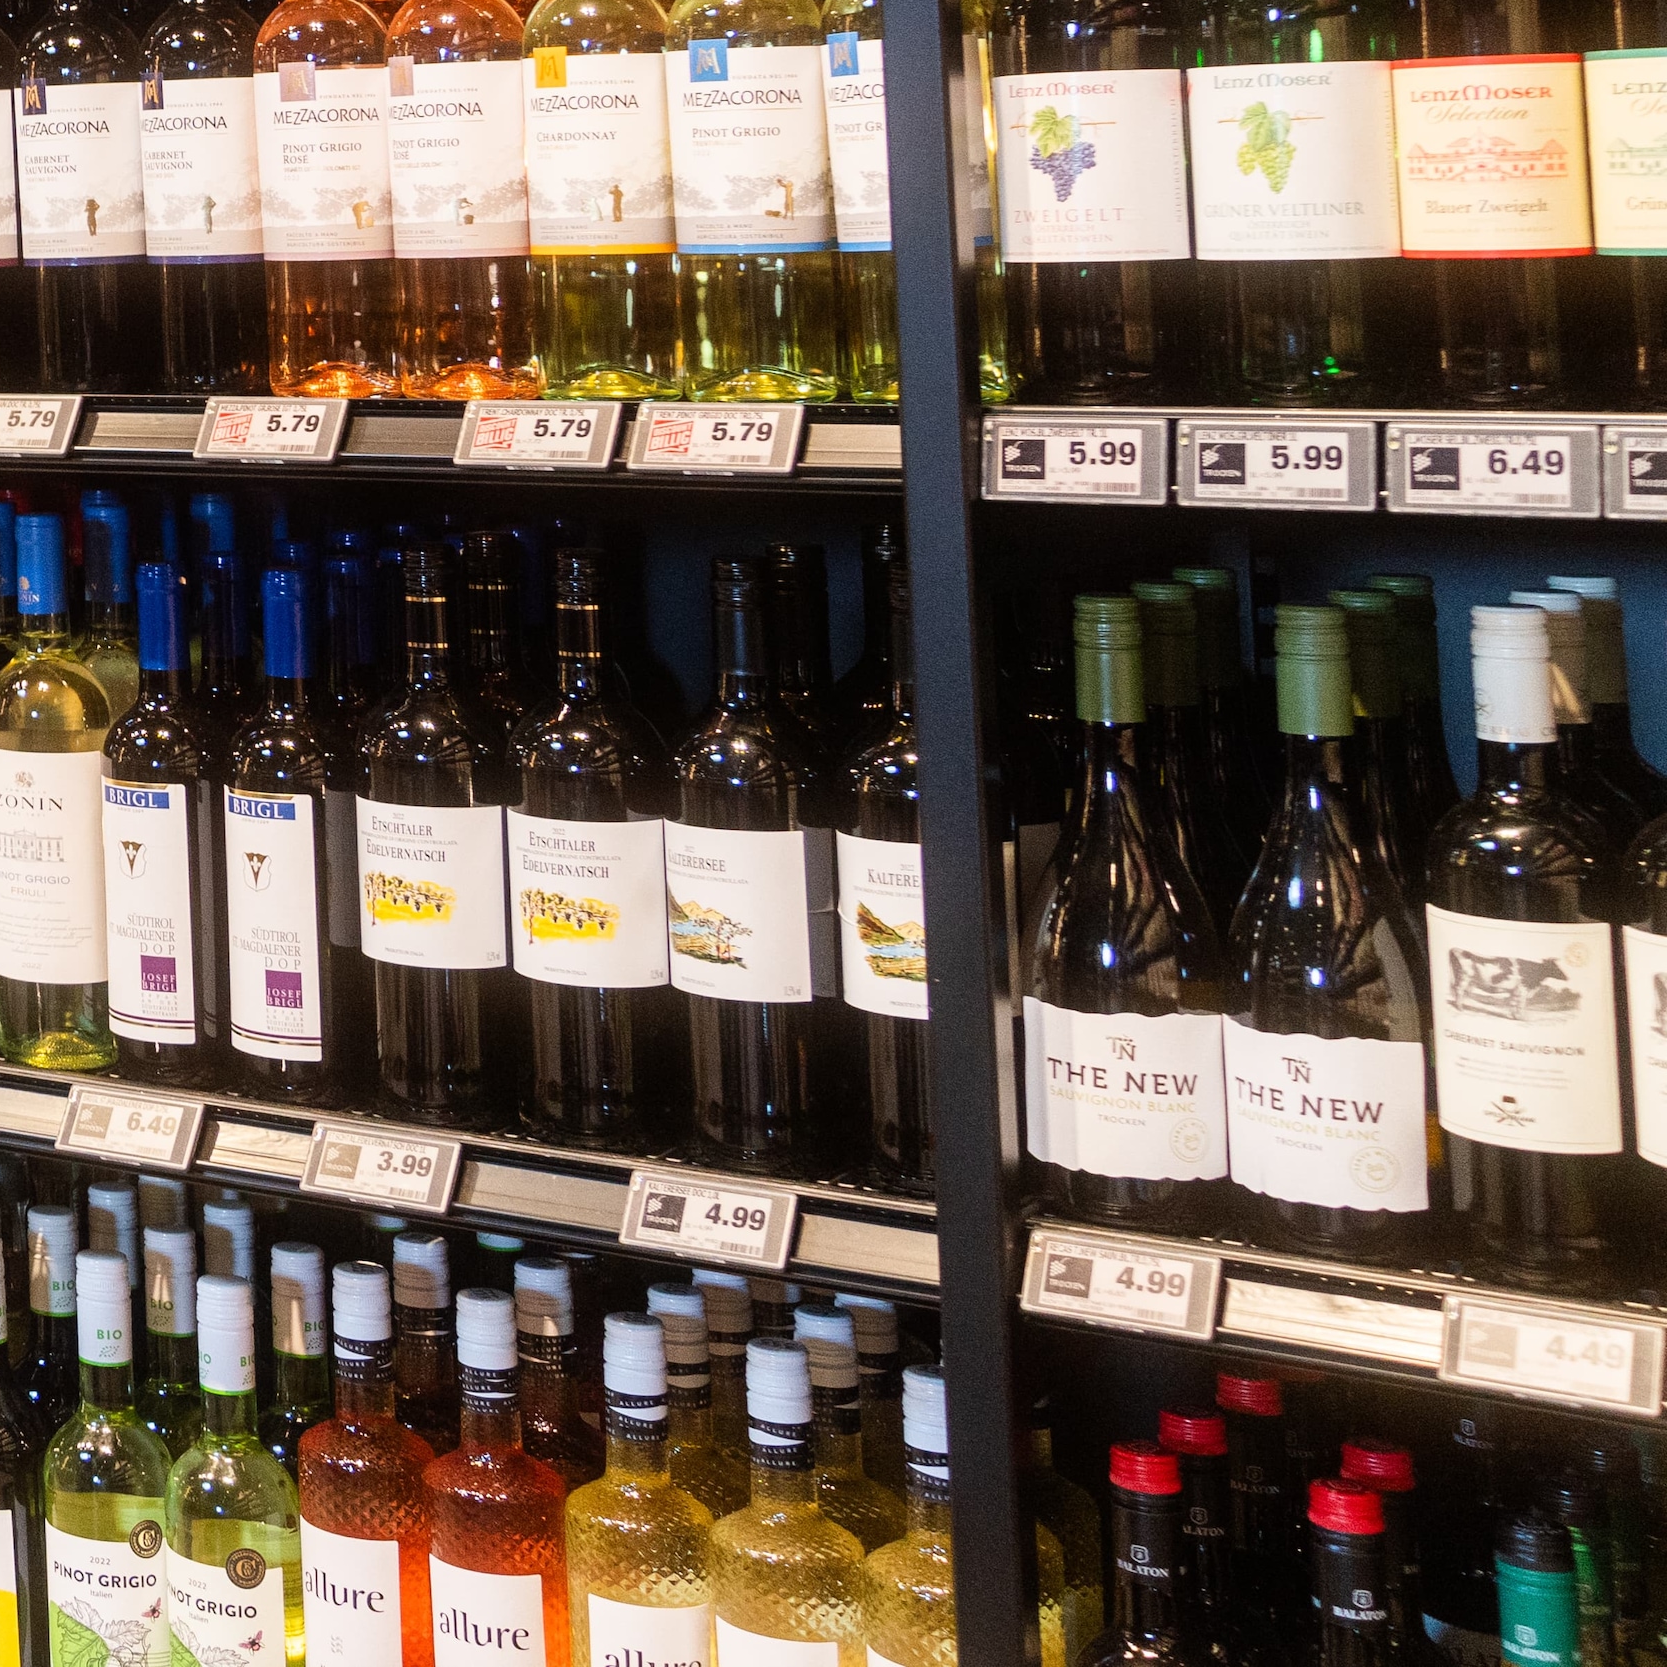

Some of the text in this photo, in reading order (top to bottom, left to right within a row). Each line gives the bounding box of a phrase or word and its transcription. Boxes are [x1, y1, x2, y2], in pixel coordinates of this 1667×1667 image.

[530, 94, 640, 113] MEZZACORONA
[683, 88, 803, 108] MEZZACORONA
[272, 107, 380, 126] MEZZACORONA
[19, 120, 110, 138] MEZZACORONA
[535, 129, 617, 143] CHARDONNAY
[692, 125, 781, 139] PINOT GRIGIO
[144, 150, 186, 161] CABERNET
[282, 141, 362, 155] PINOT GRIGIO
[24, 154, 70, 165] CABERNET
[144, 160, 193, 171] SAUVIGNON
[282, 154, 310, 166] ROSÉ
[24, 164, 77, 175] SAUVIGNON
[1014, 207, 1125, 224] ZWEIGELT
[1267, 201, 1365, 218] VELTLINER
[1425, 198, 1549, 216] Blauer Zweigelt
[6, 410, 55, 429] 5.79
[267, 414, 320, 432] 5.79
[534, 418, 591, 438] 5.79
[477, 428, 515, 448] BILLIG
[711, 422, 773, 442] 5.79
[651, 431, 691, 452] BILLIG
[1069, 441, 1136, 465] 5.99
[1271, 445, 1343, 470] 5.99
[1489, 449, 1564, 475] 6.49
[108, 788, 158, 808] BRIGL
[232, 798, 285, 819] BRIGL
[371, 816, 433, 838] ETSCHTALER
[529, 831, 596, 852] ETSCHTALER
[366, 840, 446, 863] EDELVERNATSCH
[522, 855, 610, 880] EDELVERNATSCH
[25, 871, 72, 885] GRIGIO
[10, 885, 47, 898] FRIULI
[127, 913, 174, 929] SÜDTIROL
[116, 925, 175, 942] MAGDALENER
[251, 926, 300, 943] SÜDTIROL
[241, 940, 301, 957] MAGDALENER
[142, 972, 175, 982] JOSEF
[142, 980, 176, 992] BRIGL
[267, 987, 301, 997] JOSEF
[267, 996, 302, 1008] BRIGL
[1499, 1041, 1586, 1056] SAUVIGNON
[1047, 1057, 1199, 1097] THE NEW
[1049, 1085, 1197, 1115] SAUVIGNON BLANC
[1234, 1075, 1385, 1125] THE NEW
[127, 1112, 177, 1137] 6.49
[1097, 1111, 1147, 1128] TROCKEN
[1323, 1125, 1381, 1143] BLANC
[1275, 1136, 1323, 1153] TROCKEN
[377, 1151, 433, 1178] 3.99
[705, 1203, 766, 1231] 4.99
[1116, 1266, 1186, 1298] 4.99
[96, 1329, 123, 1340] BIO
[1544, 1333, 1626, 1371] 4.49
[89, 1556, 112, 1567] 2022
[54, 1560, 158, 1590] PINOT GRIGIO
[305, 1565, 386, 1614] allure
[196, 1597, 258, 1620] GRIGIO
[438, 1608, 531, 1652] allure
